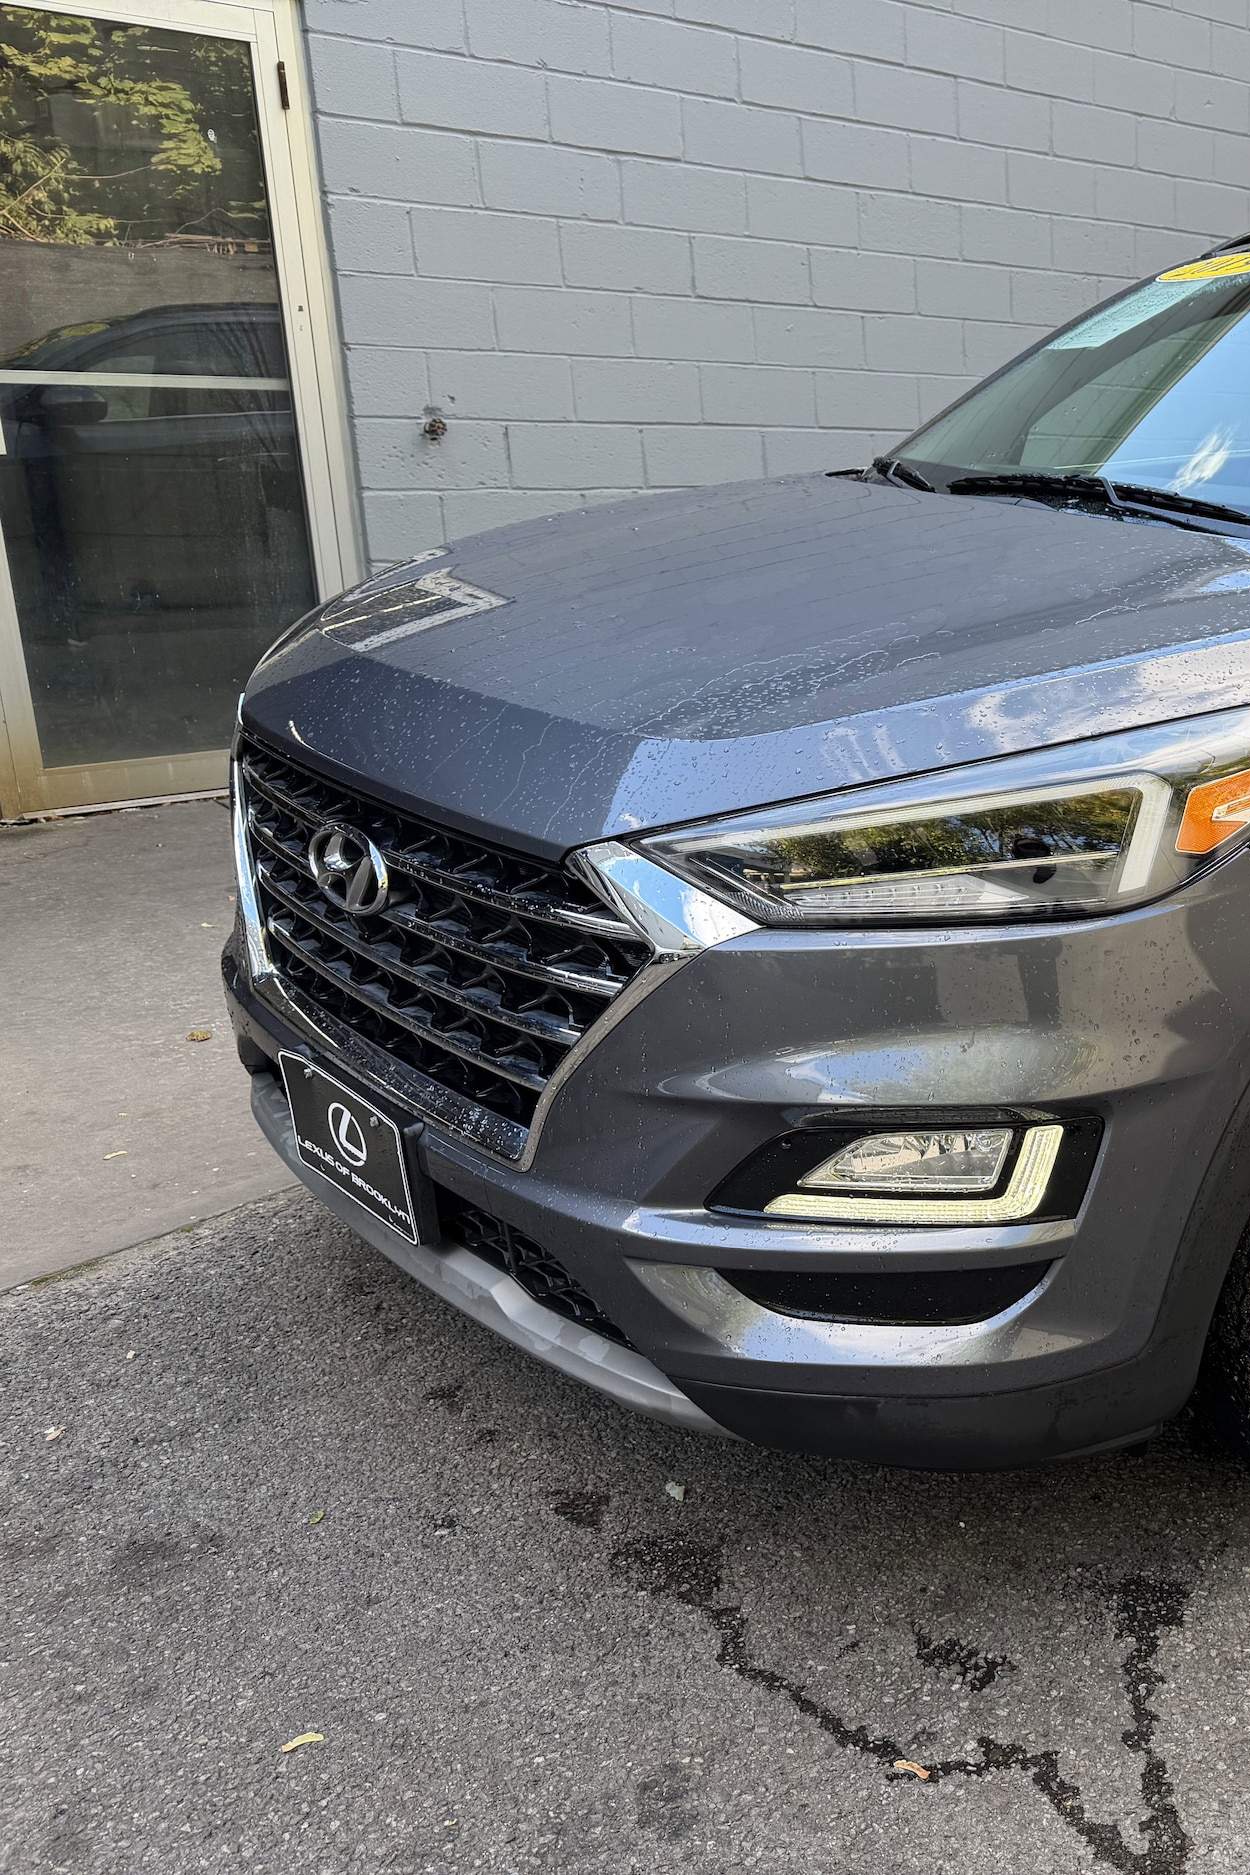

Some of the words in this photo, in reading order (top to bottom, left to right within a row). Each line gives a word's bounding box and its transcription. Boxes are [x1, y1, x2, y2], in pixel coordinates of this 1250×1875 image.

[297, 1134, 335, 1167] LEXUS
[335, 1160, 351, 1177] OF
[350, 1171, 411, 1225] BROOKLYN
